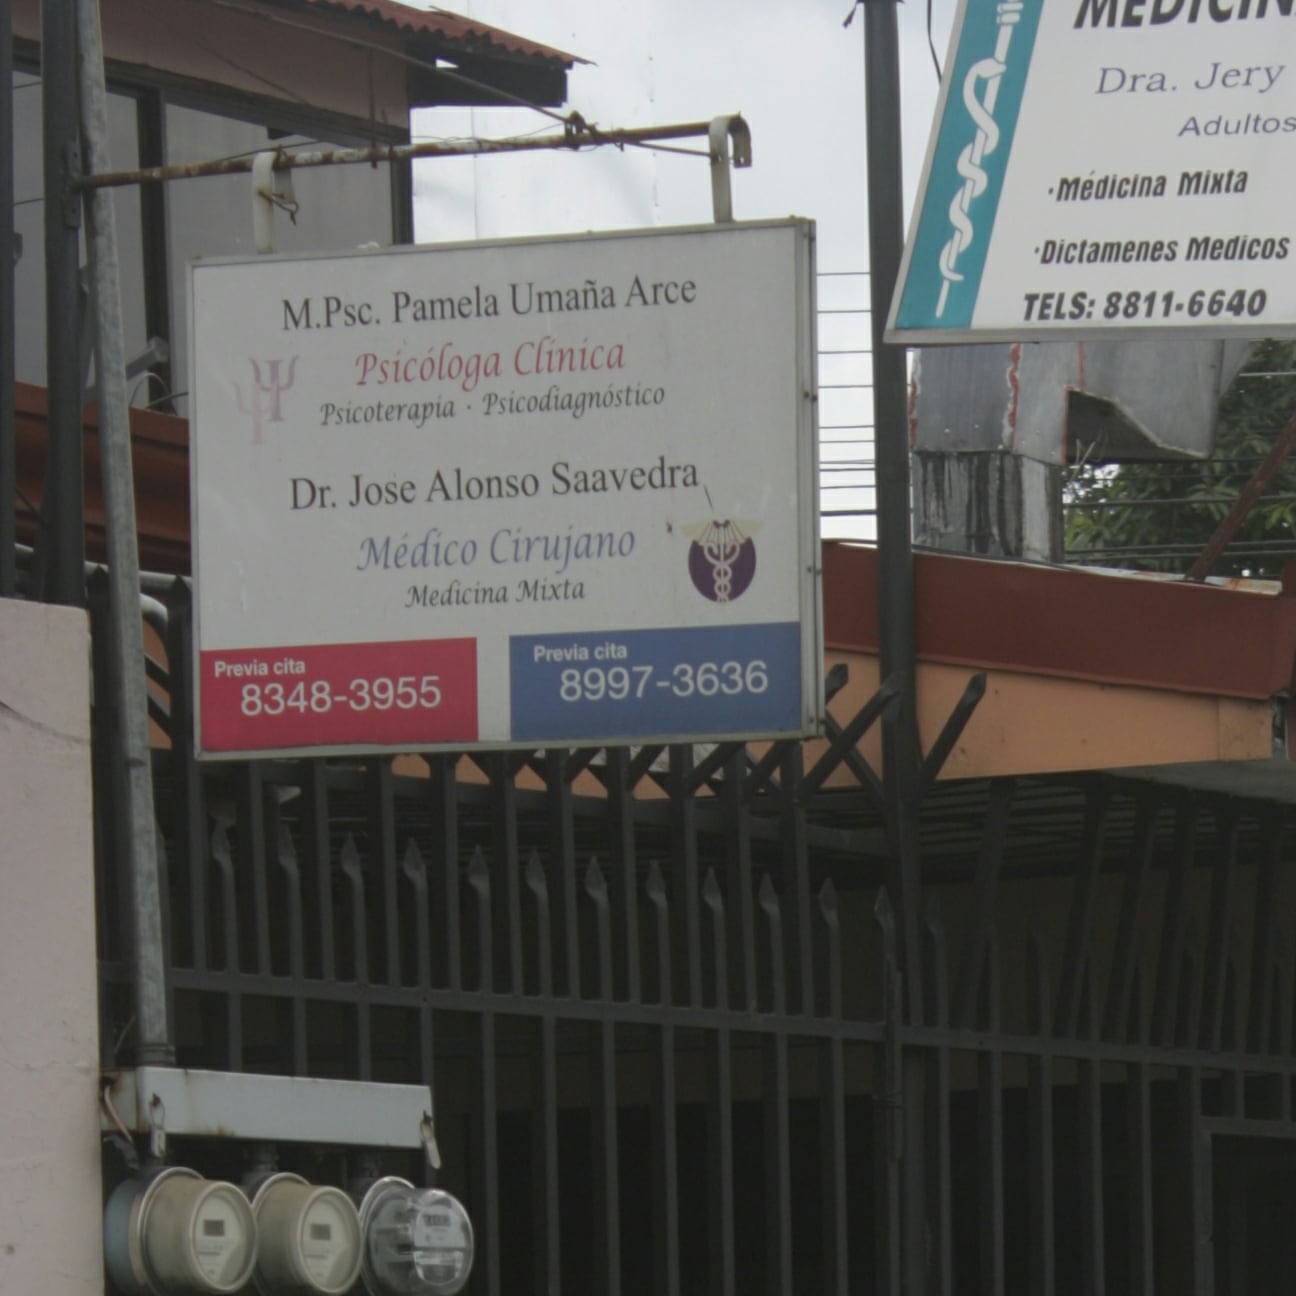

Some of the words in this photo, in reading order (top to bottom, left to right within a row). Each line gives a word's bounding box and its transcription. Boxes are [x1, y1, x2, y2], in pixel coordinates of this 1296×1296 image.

[1095, 66, 1178, 95] Dra.
[1194, 62, 1287, 94] Jery
[1177, 169, 1249, 196] Mixta
[1040, 239, 1179, 265] Dictamenes
[1185, 235, 1290, 262] Medicos
[282, 296, 381, 331] M.Psc.
[392, 285, 500, 323] Pamela
[509, 280, 616, 315] Umaña
[624, 274, 697, 307] Arce
[1023, 291, 1096, 321] TELS:
[1103, 288, 1268, 319] 8811-6640
[355, 342, 501, 393] Psicóloga
[320, 394, 456, 428] Psicoterapia
[482, 382, 666, 420] Psicodiagnóstico
[290, 477, 336, 510] Dr.
[349, 474, 417, 507] Jose
[426, 468, 540, 503] Alonso
[551, 456, 700, 495] Saavedra
[355, 527, 478, 572] Médico
[490, 524, 635, 574] Cirujano
[404, 579, 508, 608] Medicina
[515, 578, 586, 603] Mixta
[214, 660, 269, 679] Previa
[273, 657, 306, 676] cita
[533, 644, 591, 664] Previa
[594, 642, 628, 660] cita
[240, 675, 442, 718] 8348-3955
[560, 660, 769, 701] 8997-3636
